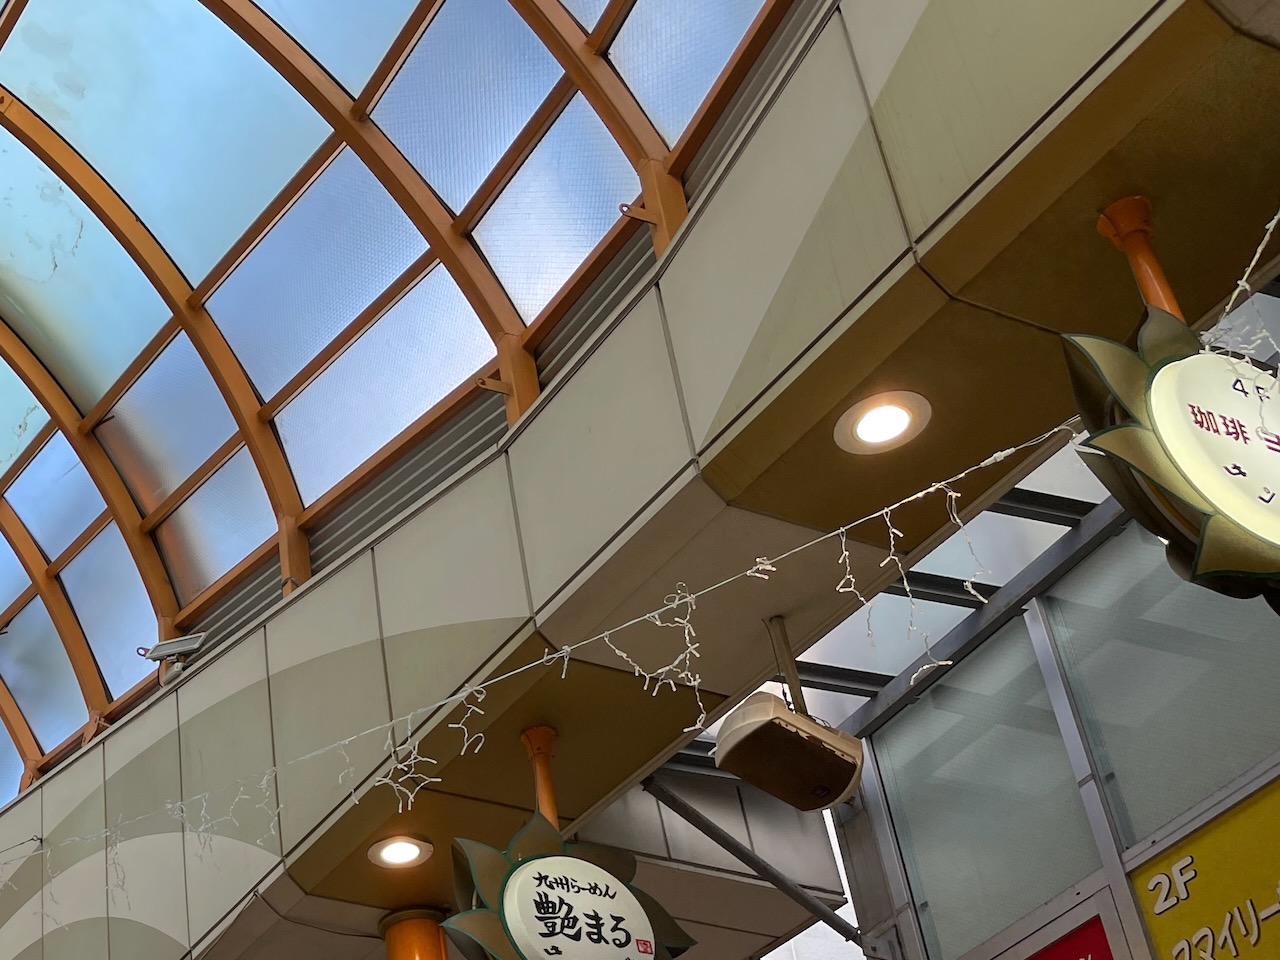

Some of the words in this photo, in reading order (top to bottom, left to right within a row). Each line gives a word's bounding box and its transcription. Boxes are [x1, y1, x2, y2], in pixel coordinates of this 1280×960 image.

[533, 872, 617, 899] 九州らーめん
[1148, 855, 1197, 915] 2F
[533, 891, 632, 948] 艶まる
